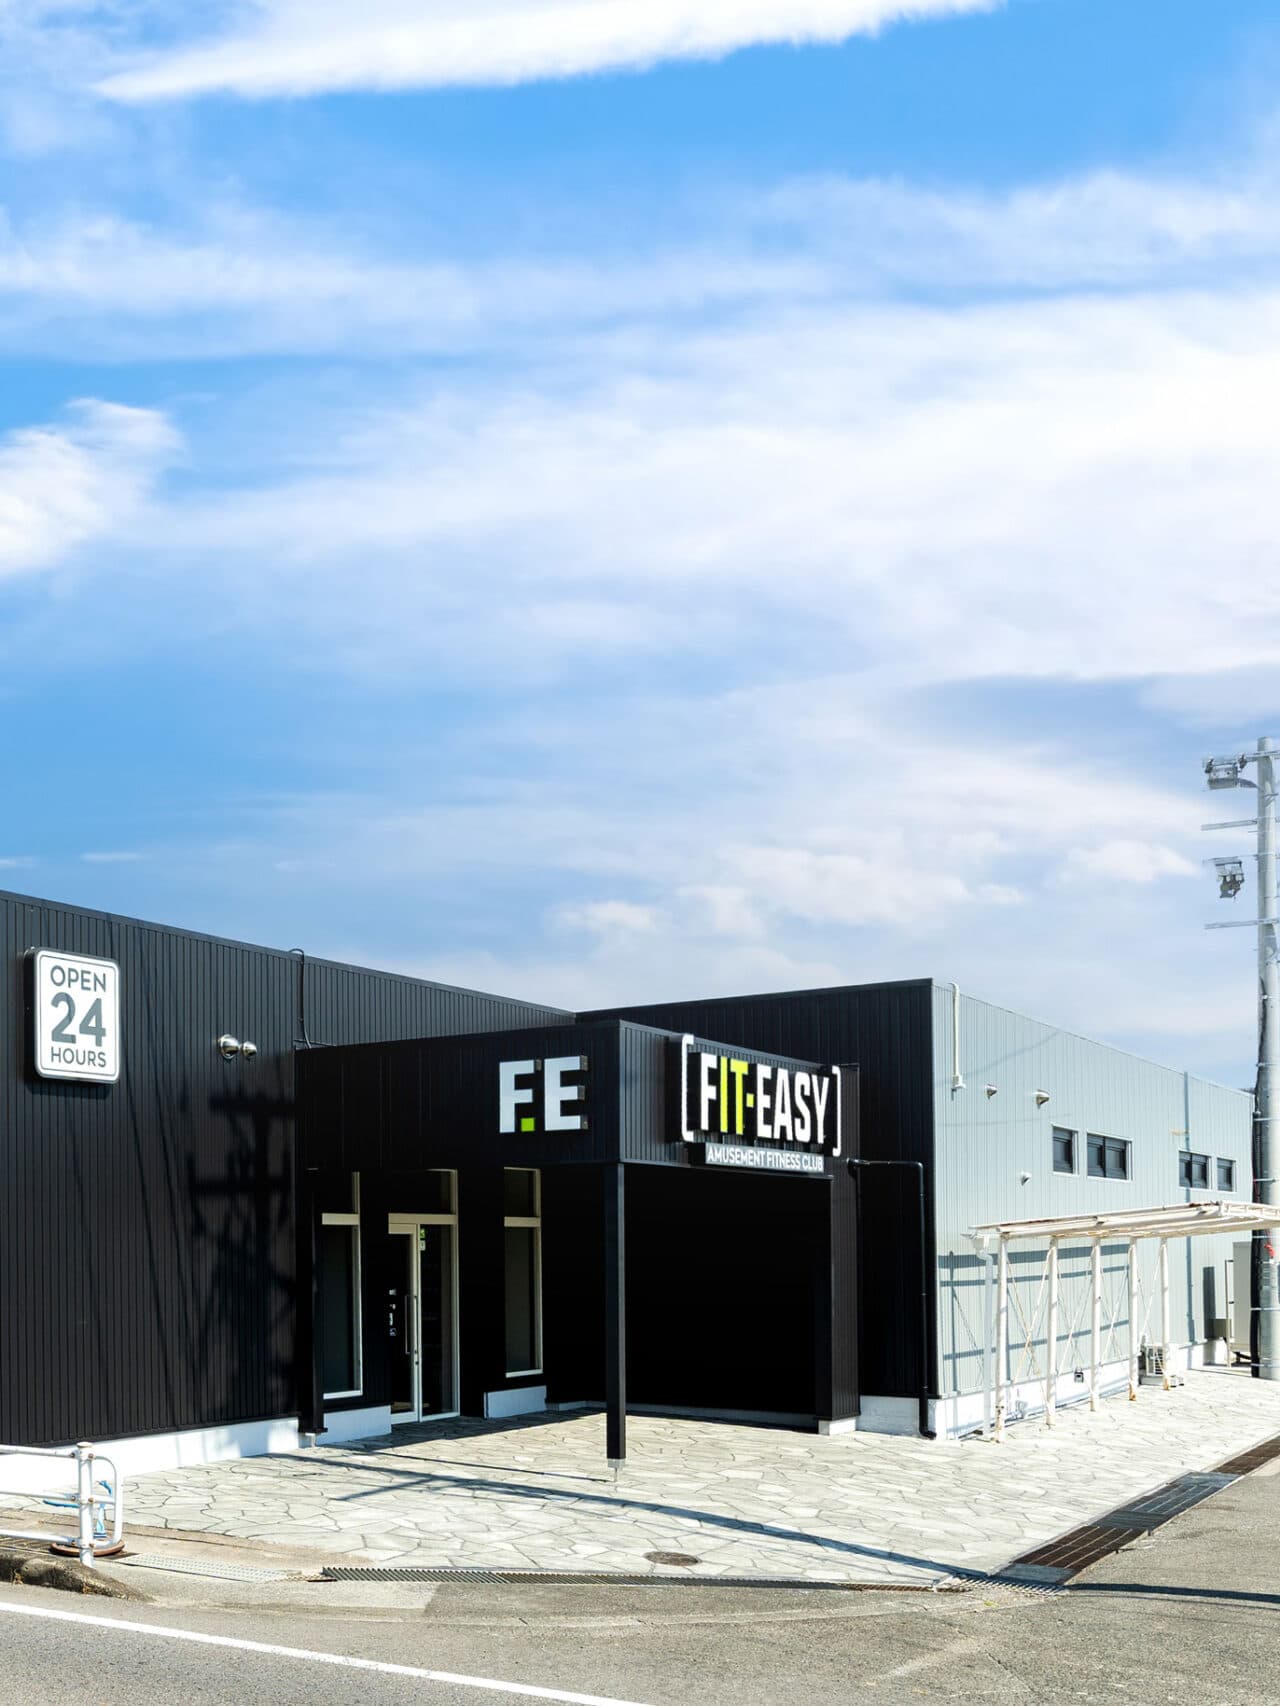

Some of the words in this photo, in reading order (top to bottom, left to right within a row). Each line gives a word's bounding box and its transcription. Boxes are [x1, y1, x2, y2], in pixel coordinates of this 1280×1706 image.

[50, 965, 106, 992] OPEN
[50, 991, 106, 1047] 24
[50, 1046, 106, 1068] HOURS
[707, 1148, 765, 1167] AMUSEMENT
[766, 1152, 801, 1170] FITNESS
[802, 1155, 824, 1171] CLUB
